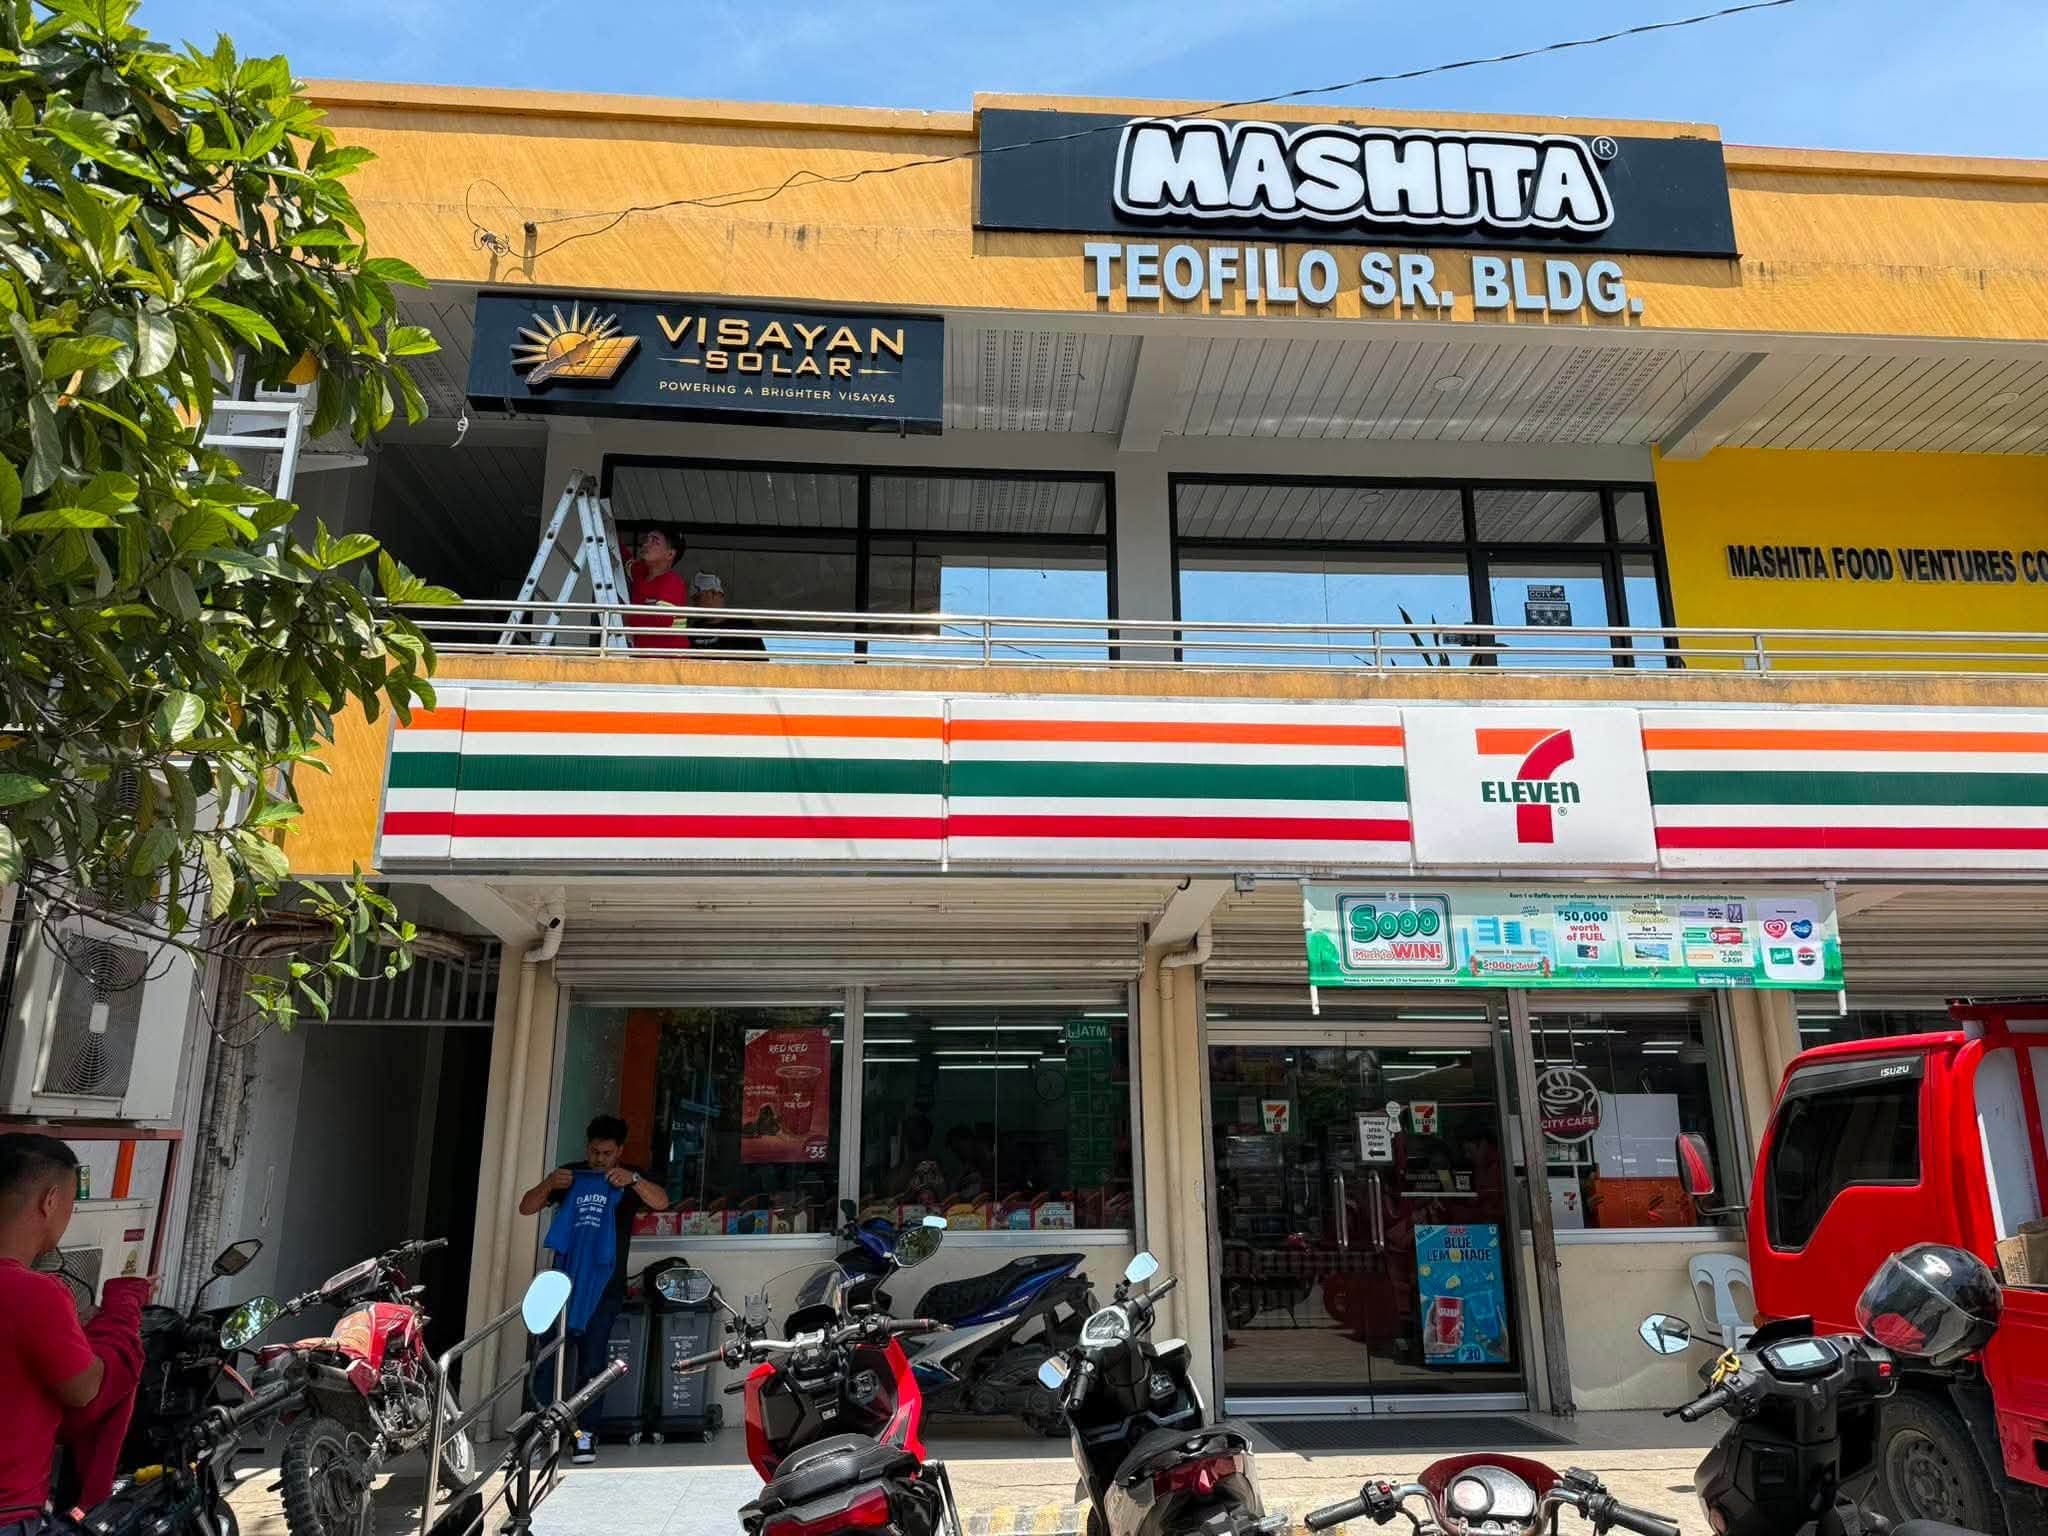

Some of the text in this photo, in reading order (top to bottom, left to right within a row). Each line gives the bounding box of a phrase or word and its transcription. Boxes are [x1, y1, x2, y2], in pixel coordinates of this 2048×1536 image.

[1122, 125, 1608, 225] MASHITA
[1083, 241, 1644, 315] TEOFILO SR. BLDG.
[655, 314, 905, 358] VISAYAN
[704, 350, 853, 377] SOLAR
[658, 381, 896, 404] POWERING A BRIGHTER VISAYAS
[1726, 544, 1828, 580] MASHITA
[1832, 547, 1894, 582] FOOD
[1898, 549, 2019, 584] VENTURES
[1475, 728, 1575, 844] 7
[1569, 923, 1600, 931] worth
[1567, 933, 1606, 941] of FUEL
[1391, 943, 1442, 960] WIN!
[1080, 1025, 1106, 1038] ATM
[787, 1043, 808, 1053] ICED
[781, 1054, 797, 1063] TEA
[1880, 1064, 1910, 1078] ISUZU
[1541, 1118, 1565, 1129] CITY
[1443, 1236, 1473, 1248] BLUE
